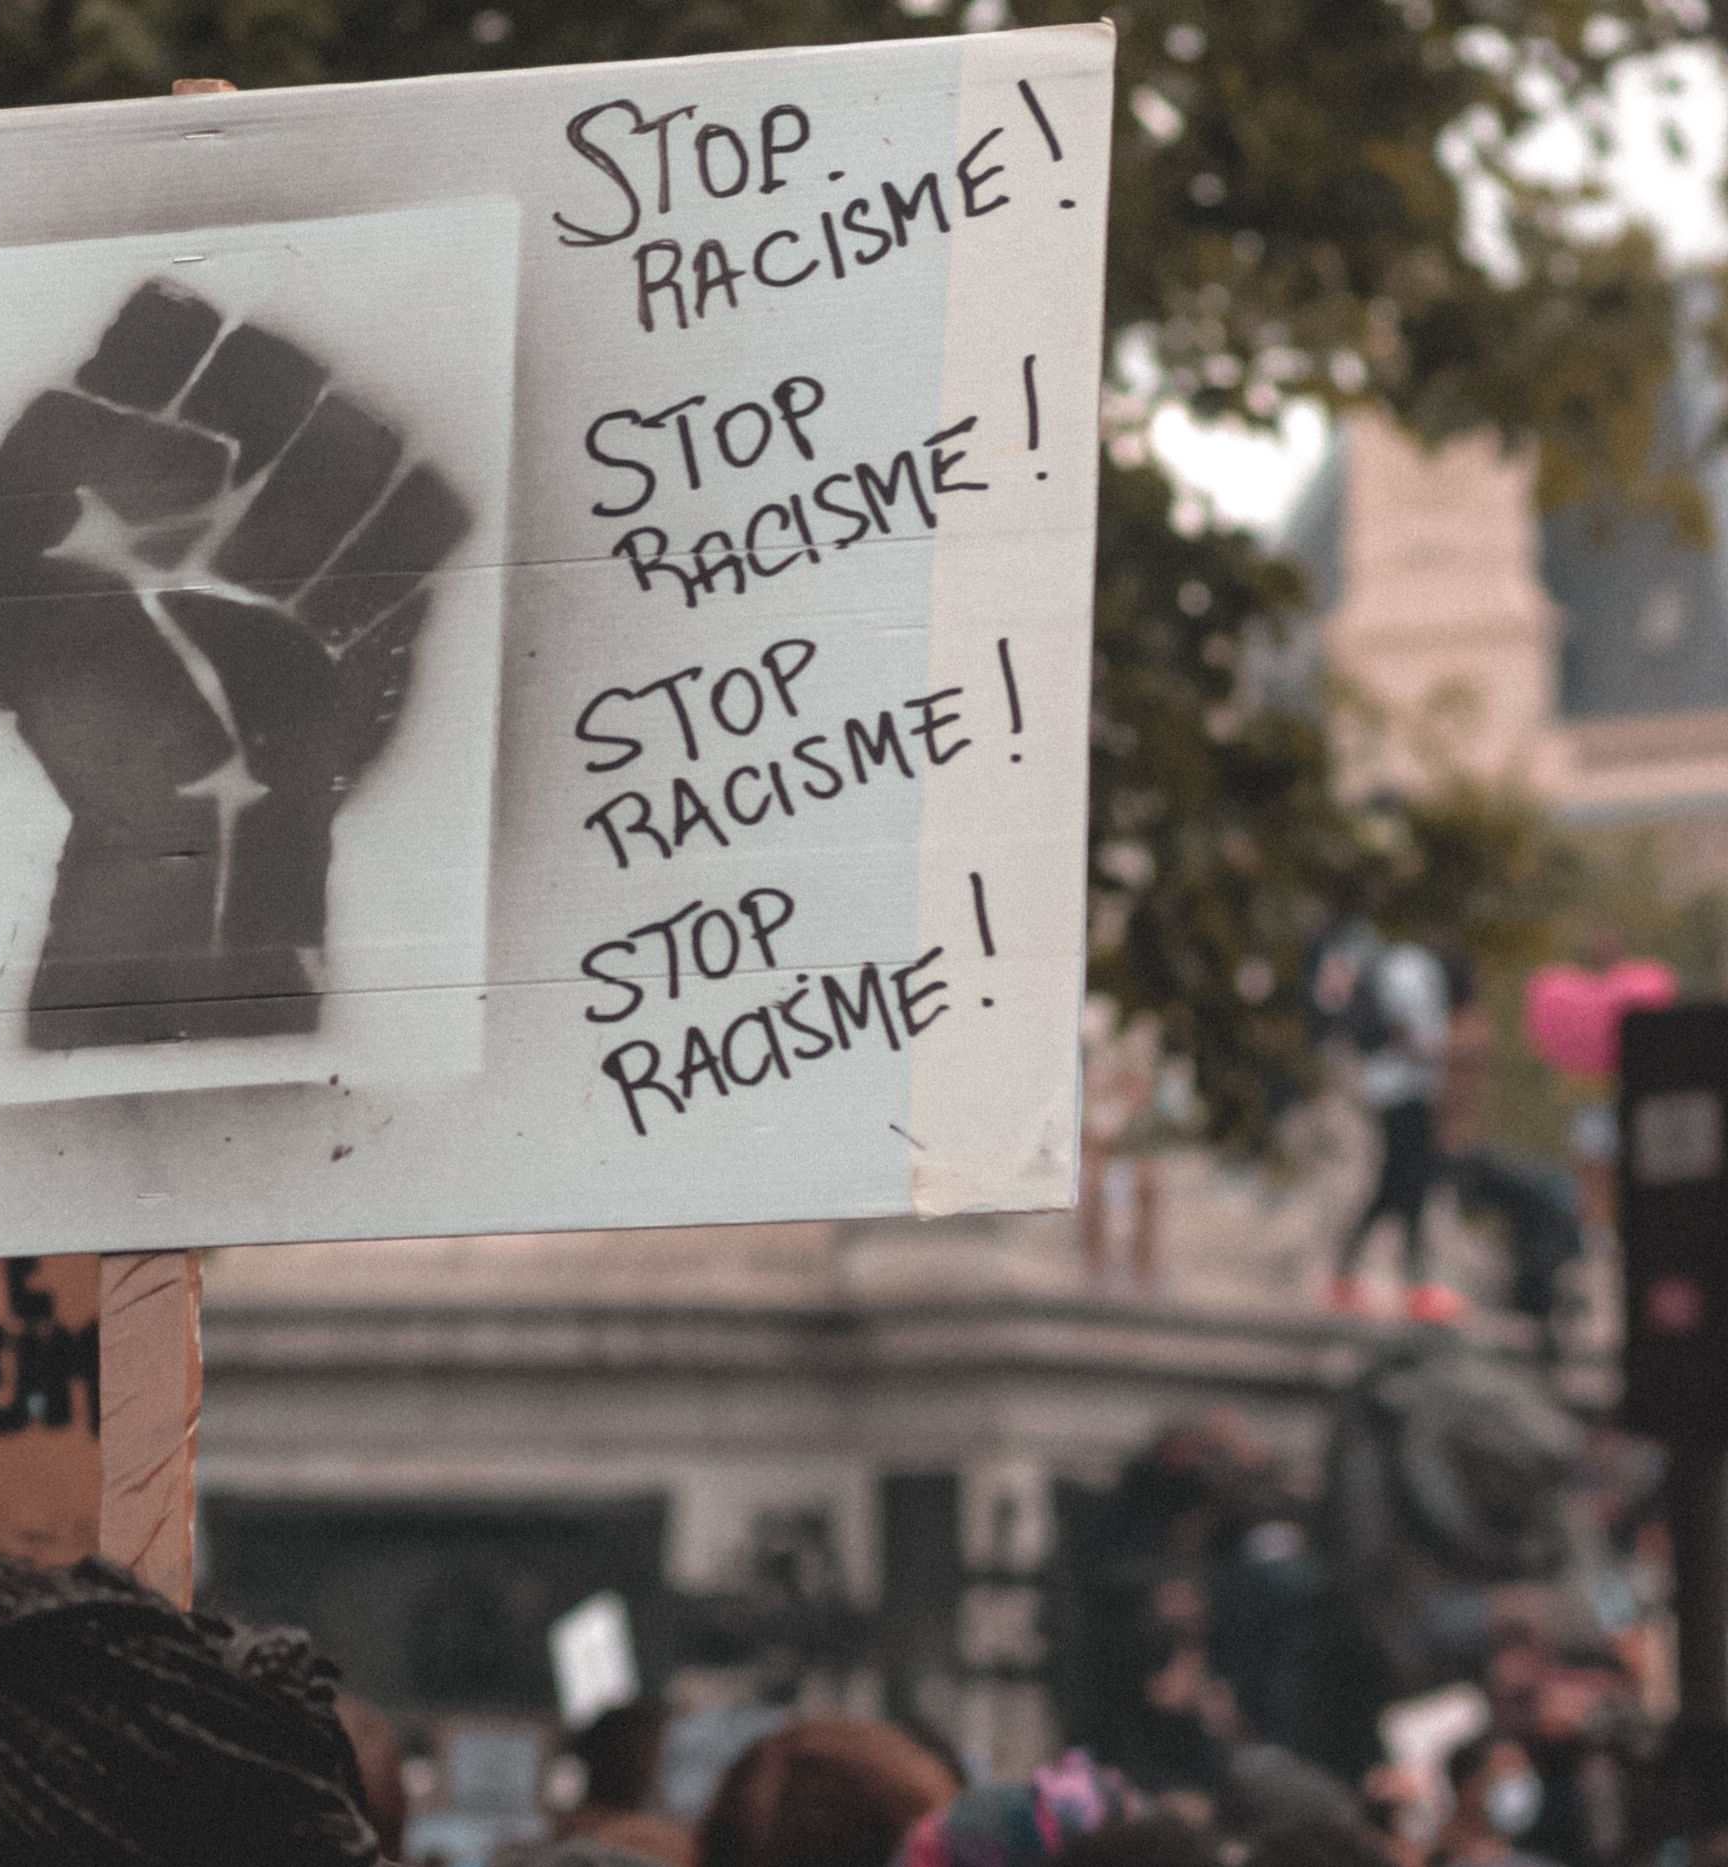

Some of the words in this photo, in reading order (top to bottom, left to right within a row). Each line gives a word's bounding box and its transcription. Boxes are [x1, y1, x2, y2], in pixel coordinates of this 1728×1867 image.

[584, 374, 826, 519] STOP
[574, 638, 818, 775] STOP
[579, 885, 797, 1026] STOP
